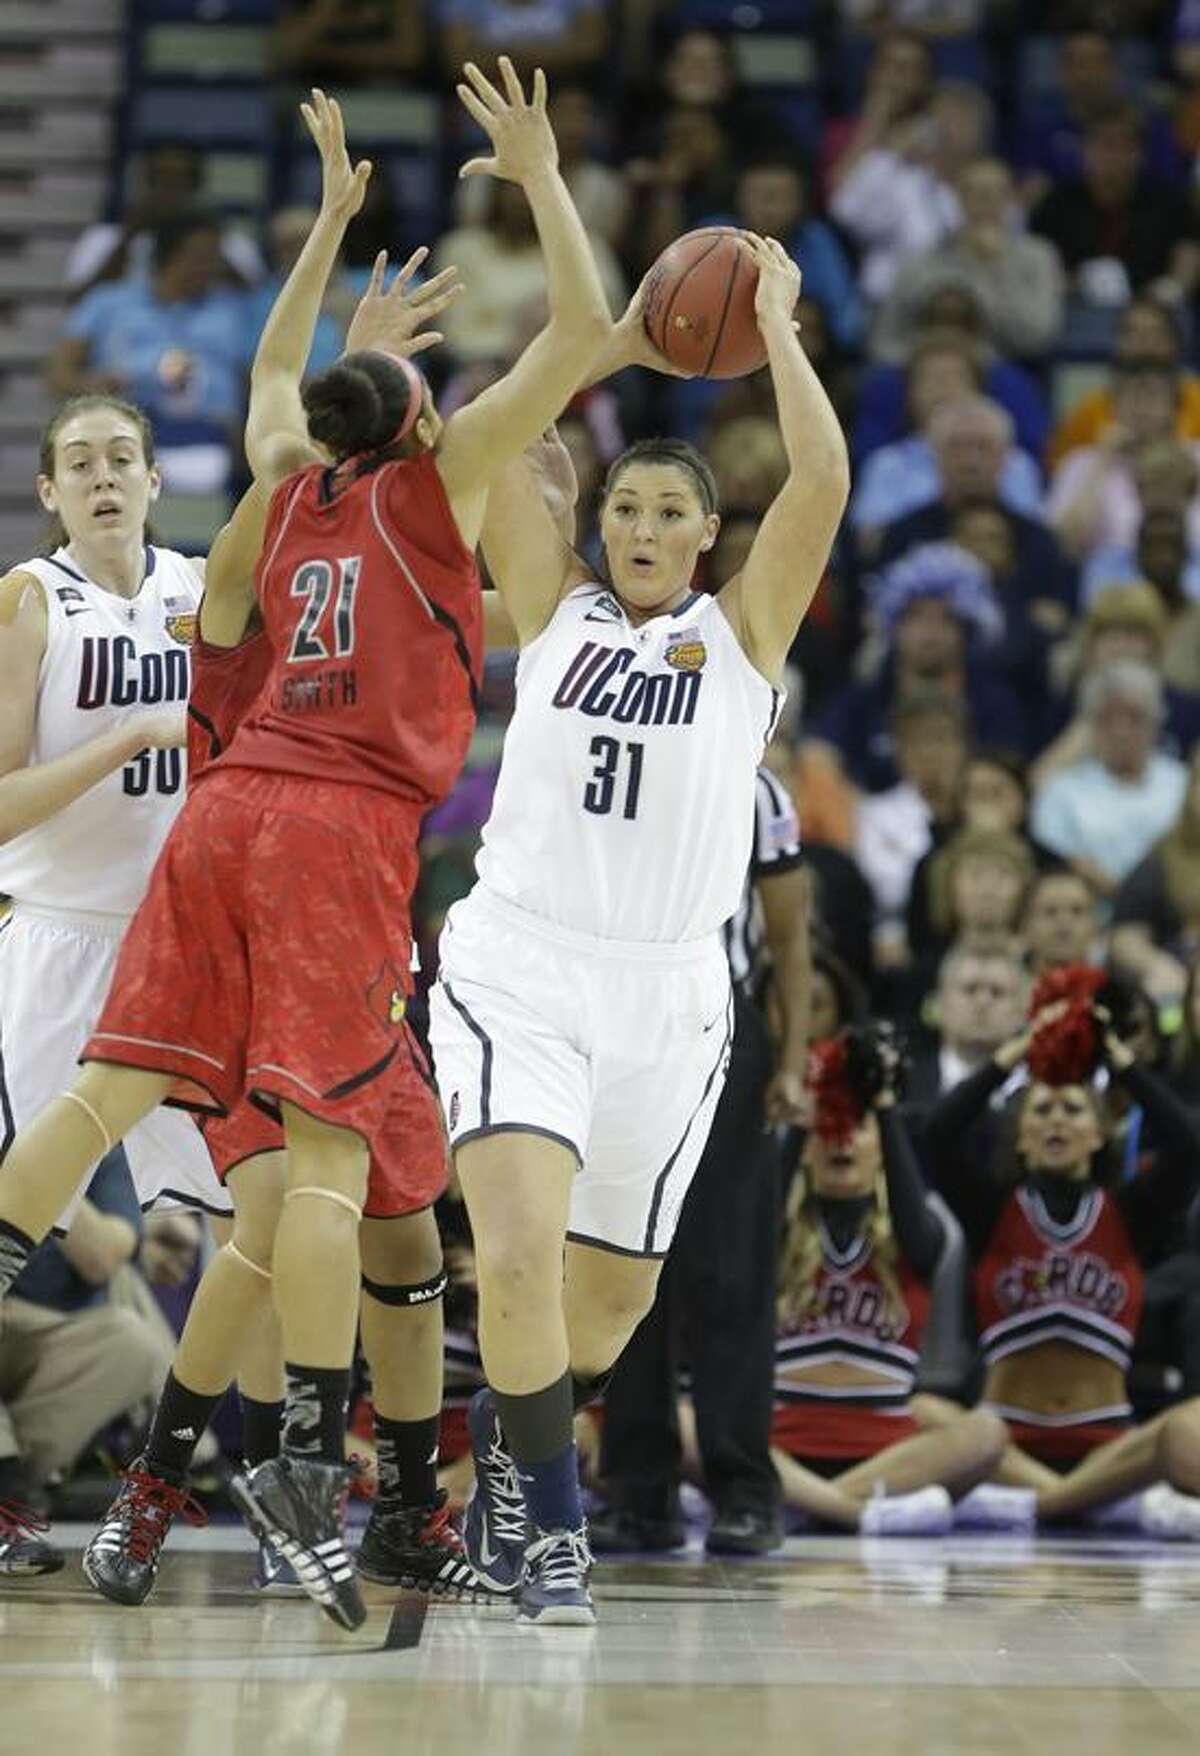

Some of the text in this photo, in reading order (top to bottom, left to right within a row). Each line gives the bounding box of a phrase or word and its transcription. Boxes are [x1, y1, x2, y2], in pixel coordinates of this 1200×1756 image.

[287, 555, 363, 664] 21
[77, 635, 190, 710] UCon
[552, 641, 702, 726] UConn
[583, 735, 644, 820] 31
